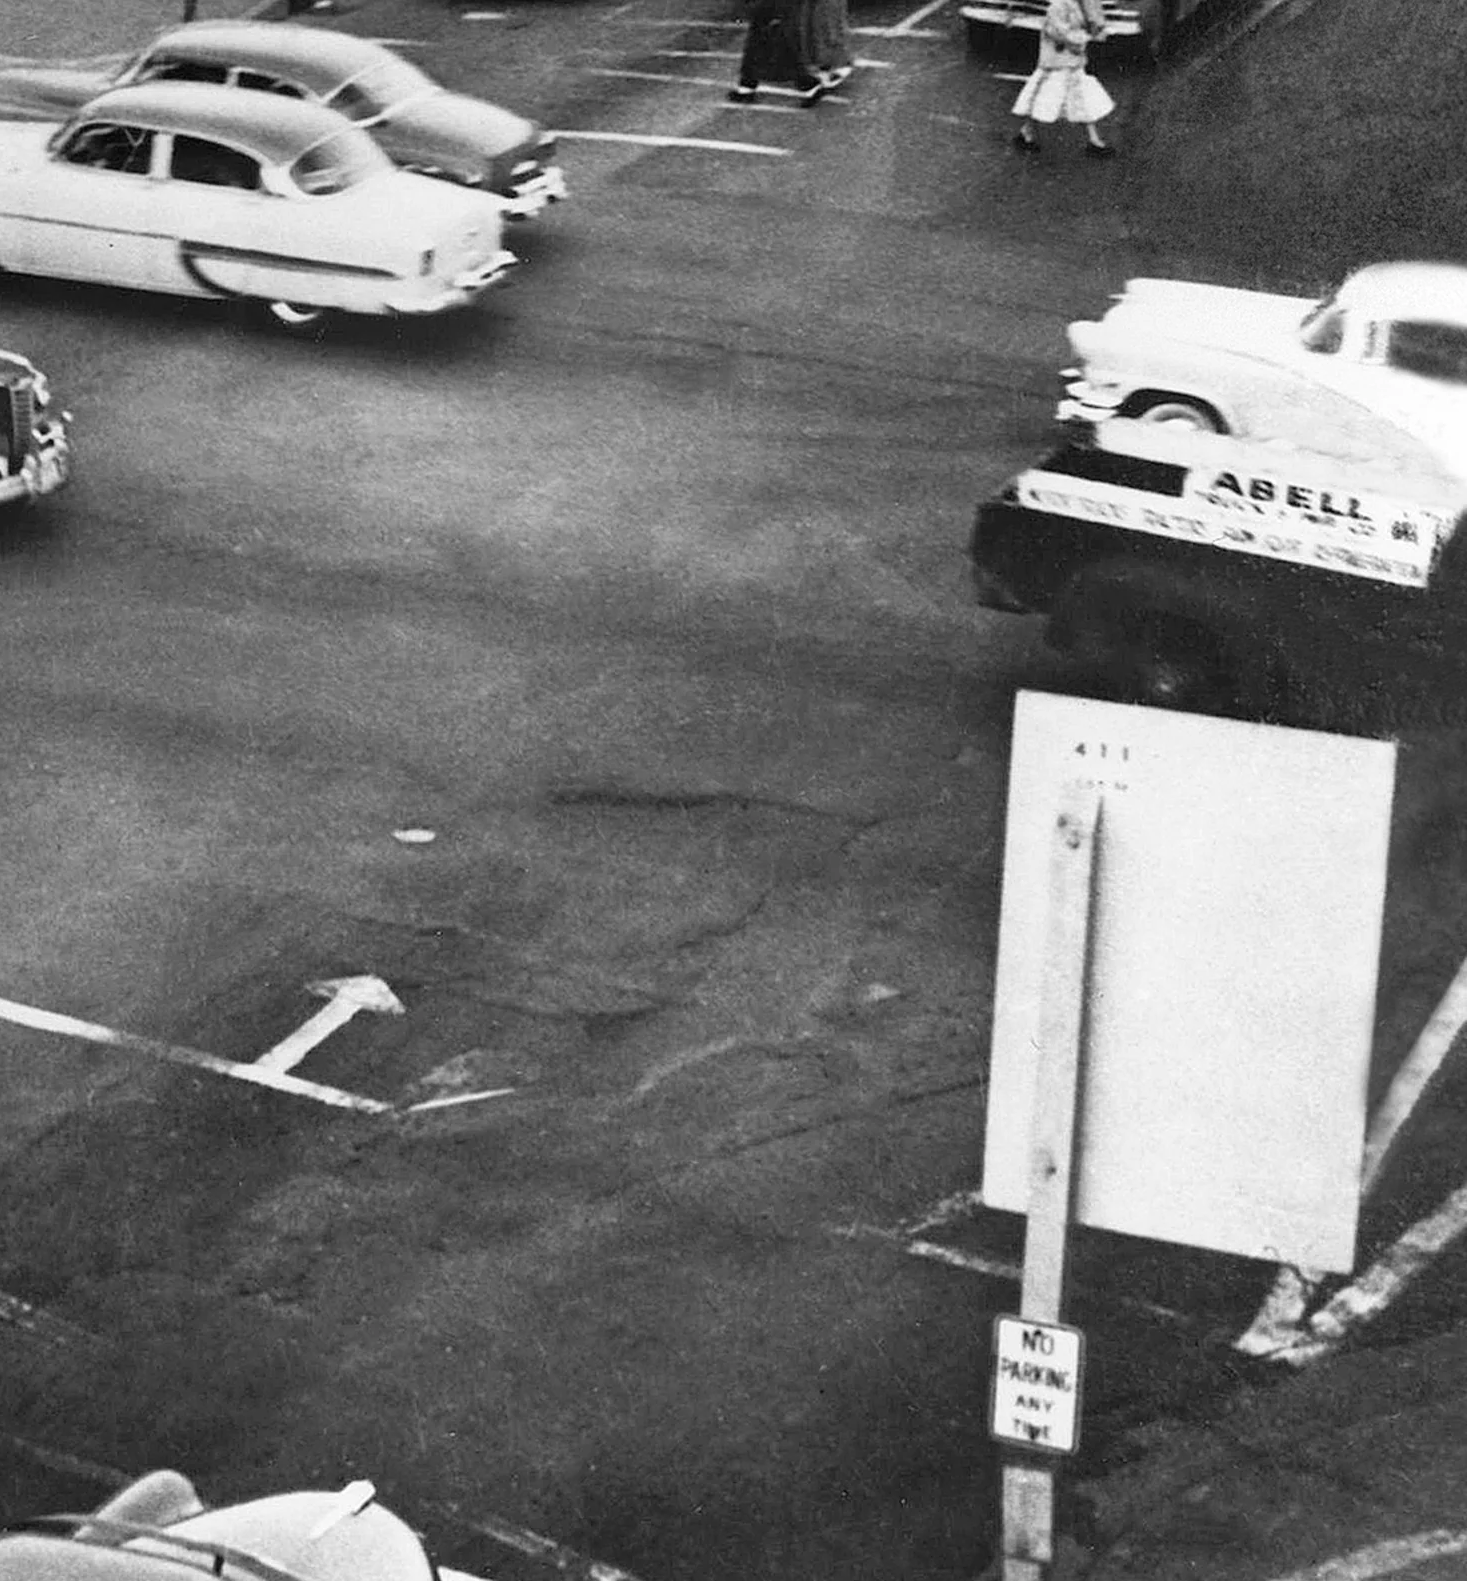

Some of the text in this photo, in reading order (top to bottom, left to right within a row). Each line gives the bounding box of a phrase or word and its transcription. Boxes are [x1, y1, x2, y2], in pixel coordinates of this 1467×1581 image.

[1214, 470, 1374, 522] ABELL
[1021, 1328, 1054, 1357] NO
[1000, 1356, 1072, 1394] PARKING
[1014, 1394, 1054, 1413] ANY
